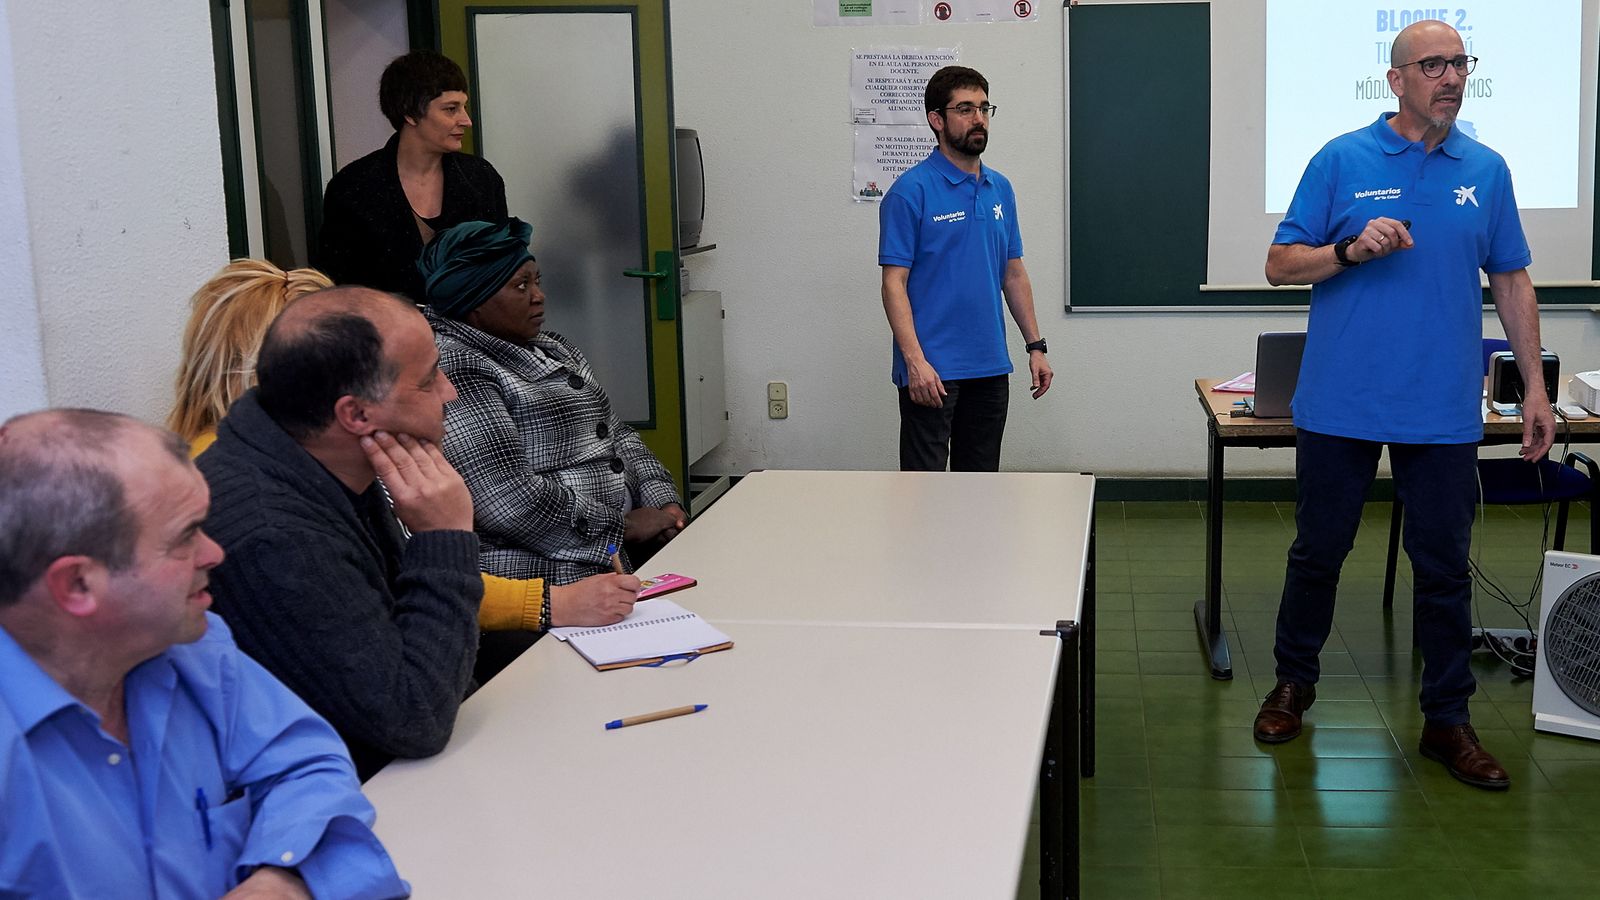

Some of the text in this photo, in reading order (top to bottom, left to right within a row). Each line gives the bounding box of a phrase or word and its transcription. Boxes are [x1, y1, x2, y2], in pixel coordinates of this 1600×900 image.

[1455, 8, 1473, 31] 2.
[1356, 76, 1492, 100] MÓDUL MOS
[1355, 188, 1401, 199] Voluntarios
[932, 210, 966, 222] Voluntarios
